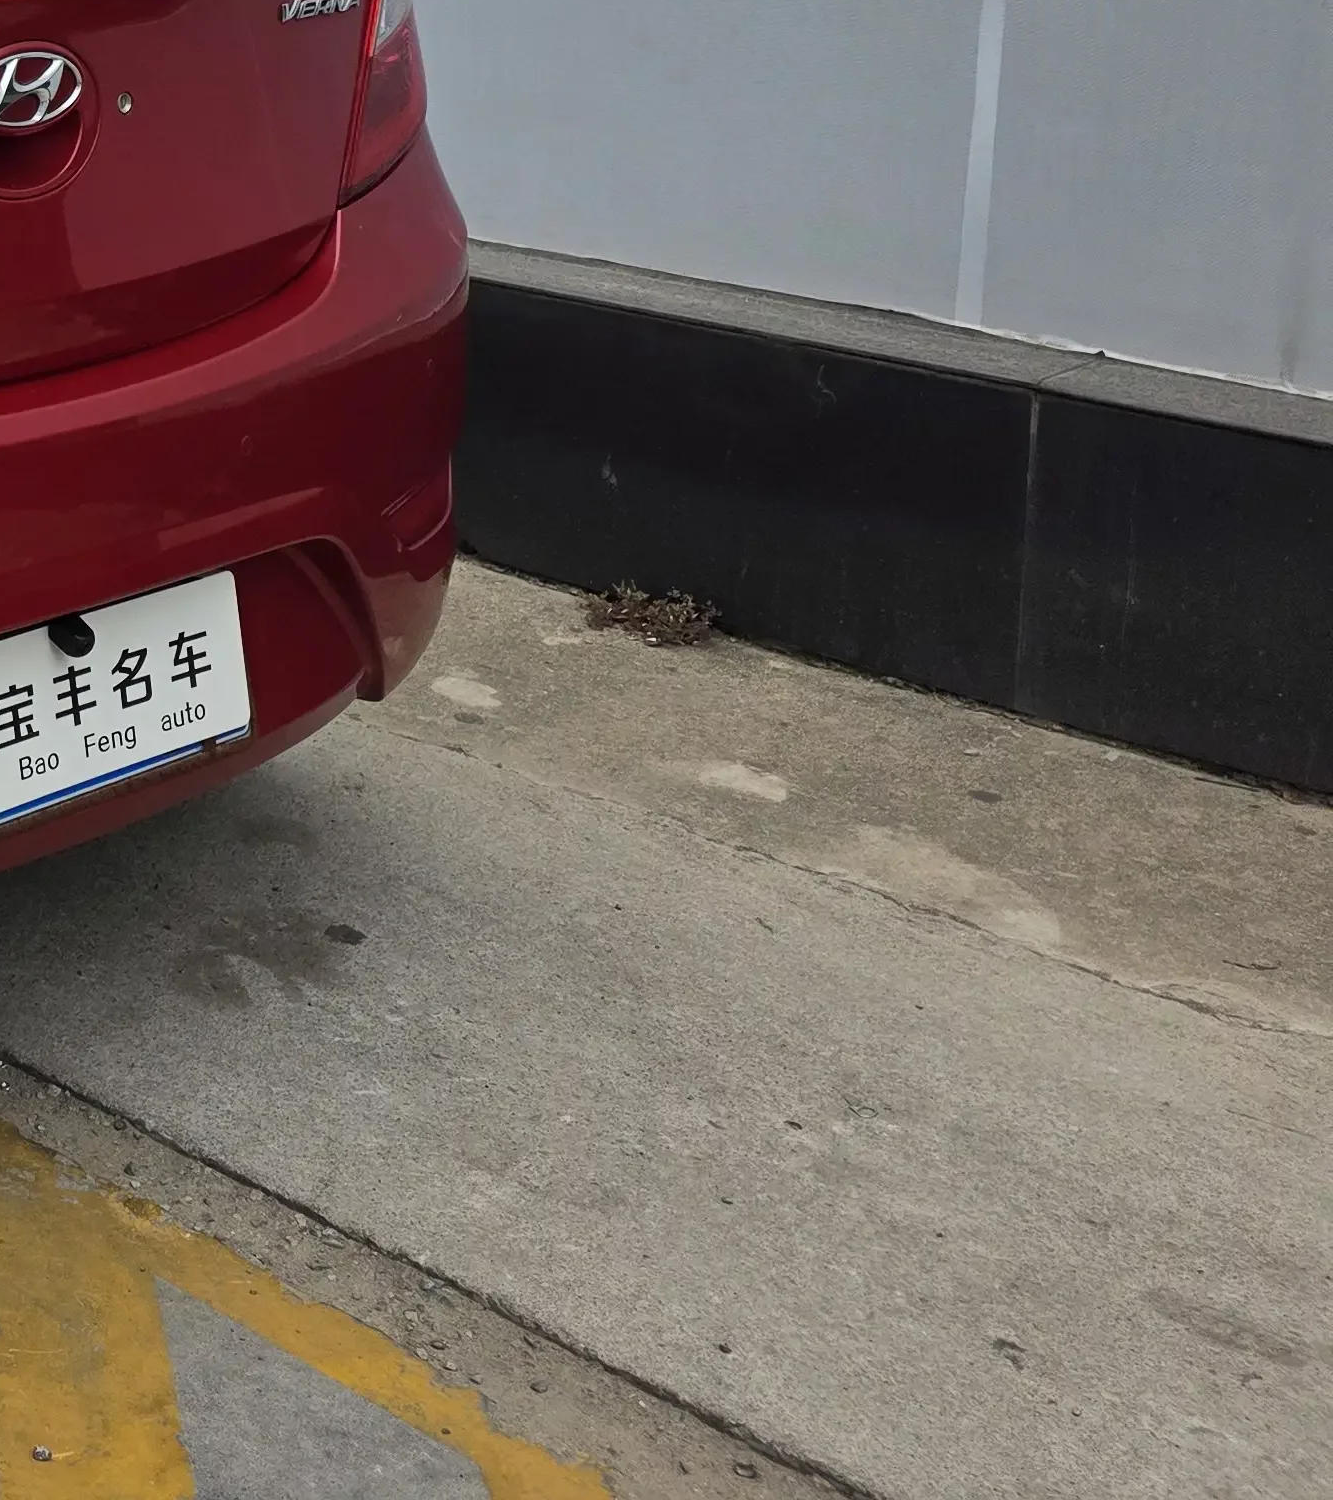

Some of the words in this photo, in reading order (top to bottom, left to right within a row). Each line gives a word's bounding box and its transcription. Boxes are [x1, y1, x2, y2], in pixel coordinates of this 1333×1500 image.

[18, 750, 60, 781] Bao
[83, 726, 138, 759] Feng
[160, 700, 207, 732] auto
